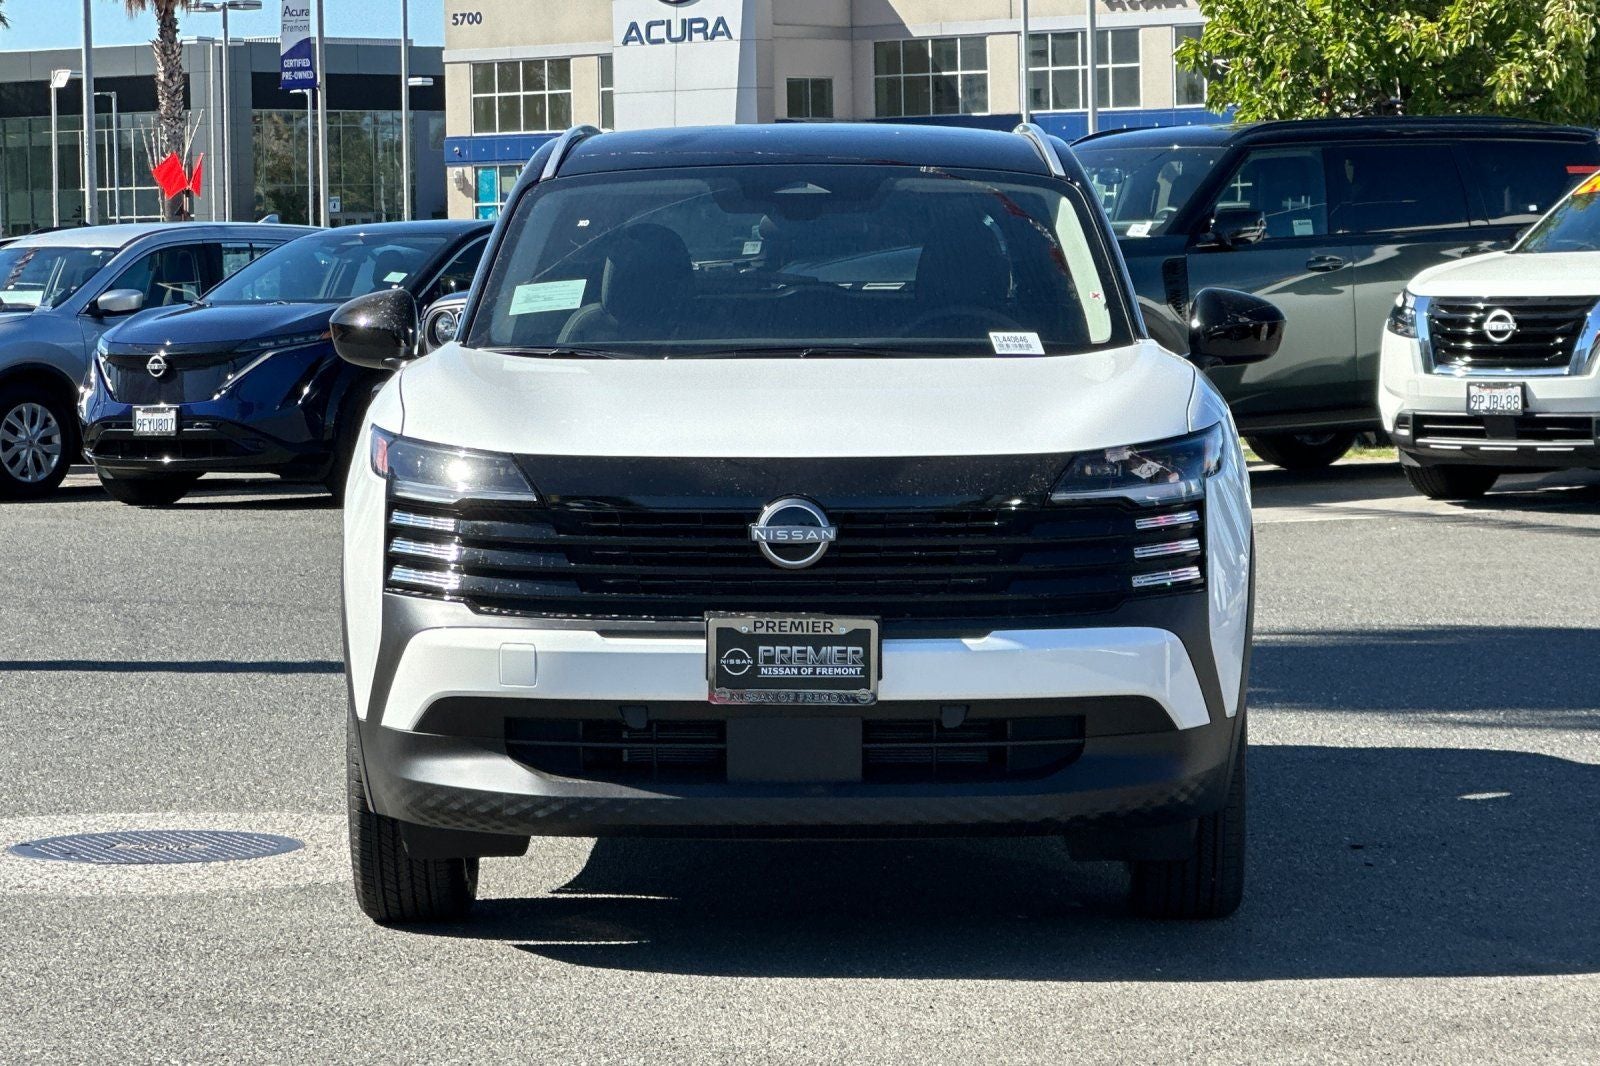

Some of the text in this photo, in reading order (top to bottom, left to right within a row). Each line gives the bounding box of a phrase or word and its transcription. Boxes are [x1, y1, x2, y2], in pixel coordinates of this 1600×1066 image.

[283, 6, 310, 17] Acura
[452, 11, 483, 26] 5700
[282, 24, 310, 32] Fremont
[622, 16, 733, 46] ACURA
[283, 58, 311, 68] CERTIFIED
[282, 70, 314, 80] PRE-OWNED
[1471, 395, 1520, 410] 9PJB488
[137, 418, 174, 431] 9FYU807
[754, 529, 835, 541] NISSAN
[753, 620, 834, 633] PREMIER
[758, 645, 865, 664] PREMIER
[761, 667, 862, 675] NISSAN OF FREMONT
[733, 692, 774, 702] NISSAN
[778, 692, 795, 701] OF
